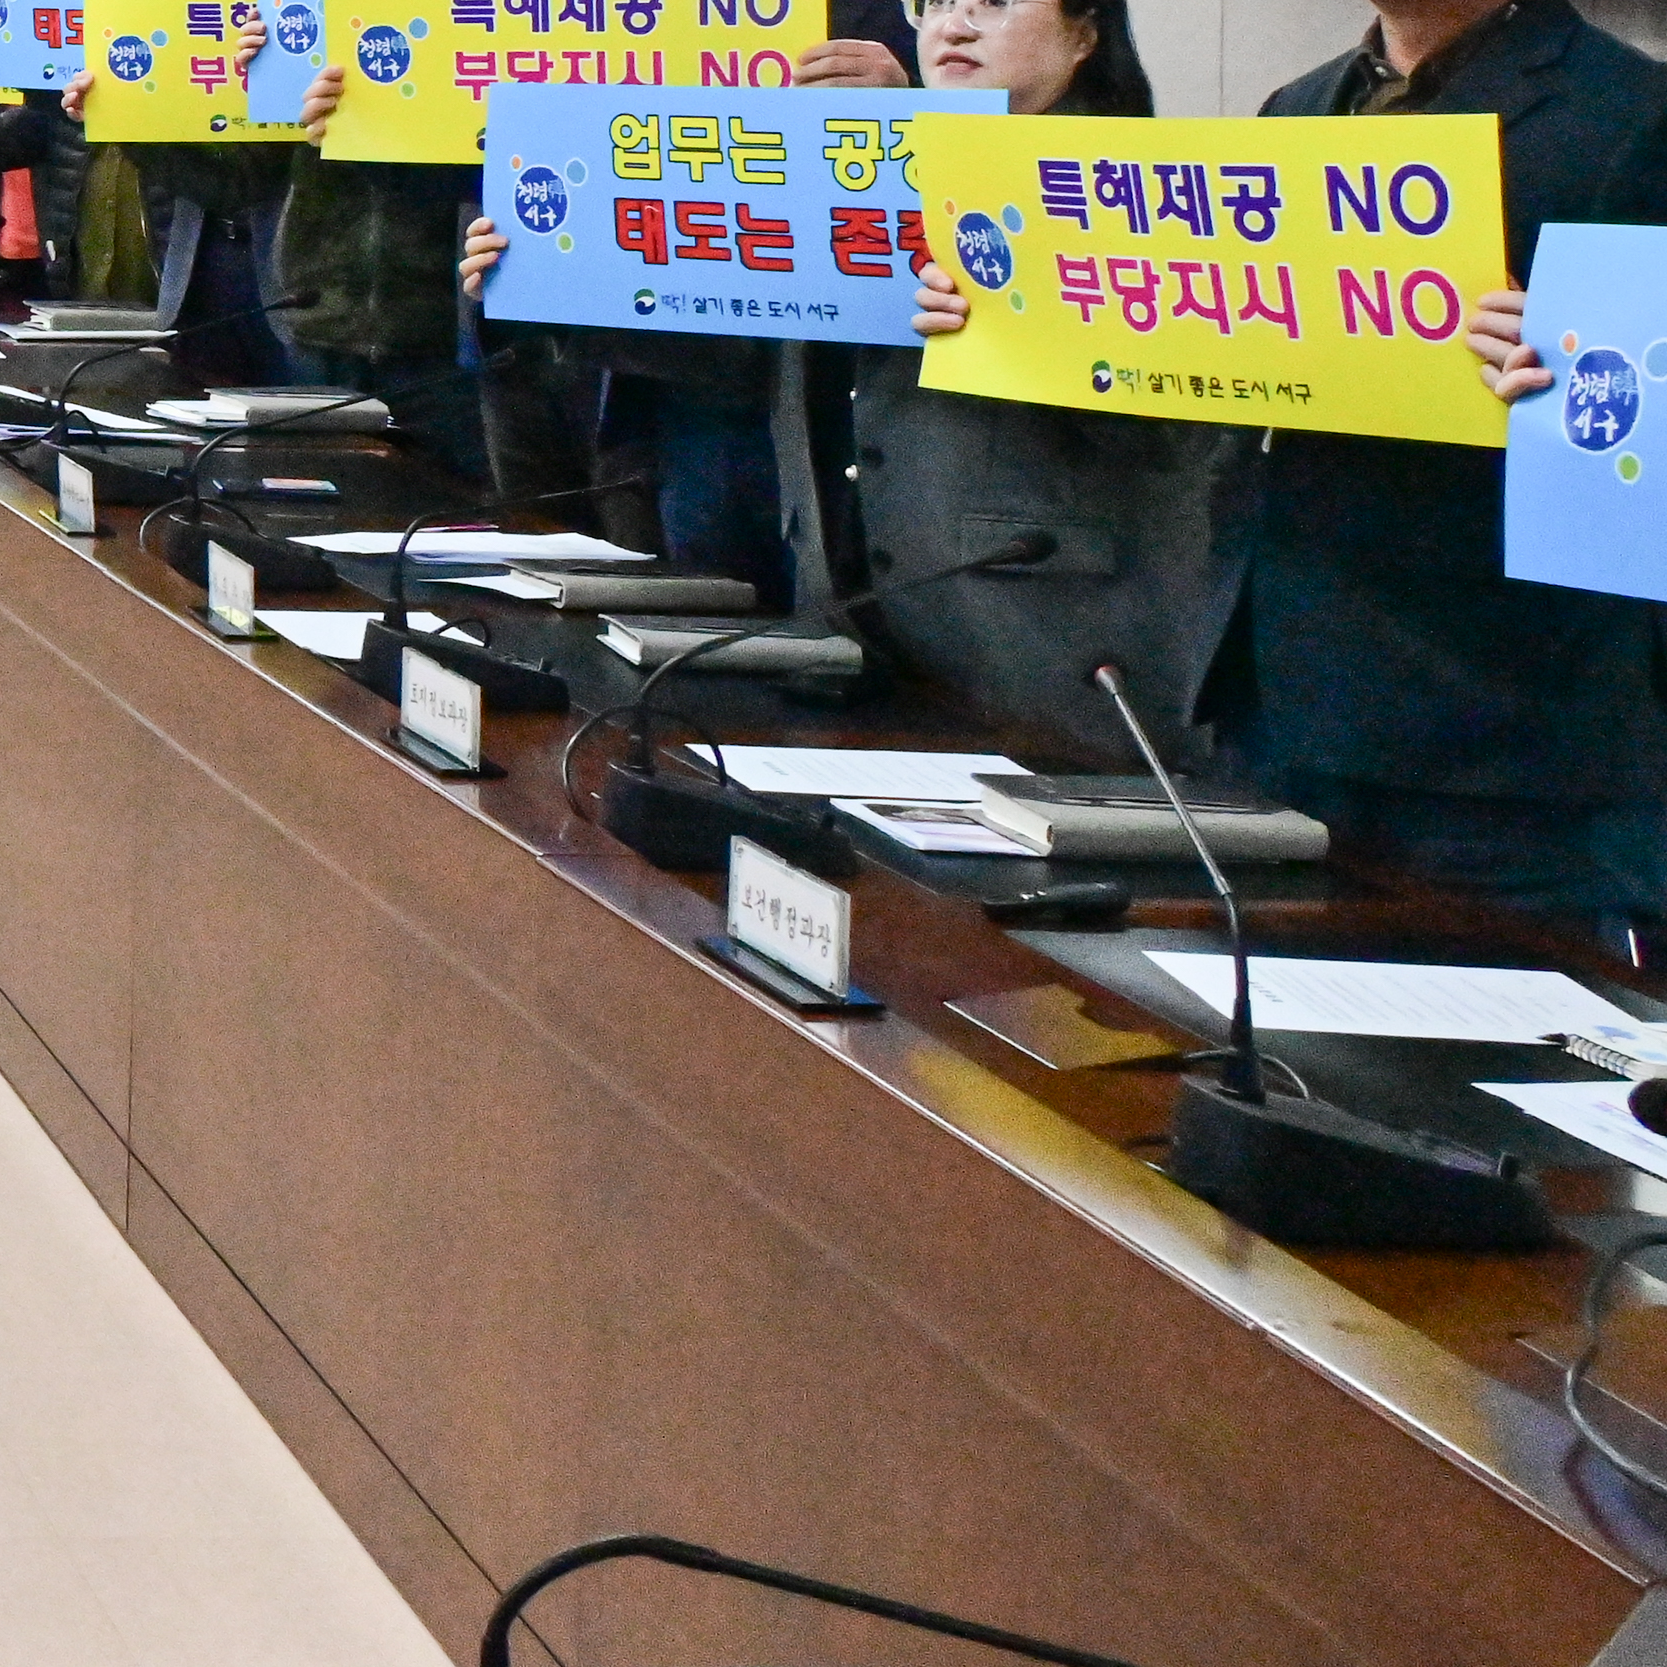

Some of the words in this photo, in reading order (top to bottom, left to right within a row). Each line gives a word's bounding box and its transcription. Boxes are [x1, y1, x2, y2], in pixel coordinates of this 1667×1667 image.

[454, 49, 664, 101] 부당지시
[701, 49, 793, 88] NO
[609, 113, 787, 185] 업무는
[614, 197, 795, 272] 태도는
[1037, 158, 1282, 243] 특혜제공
[1324, 163, 1451, 236] NO
[692, 296, 725, 314] 살기
[730, 298, 761, 318] 좋은
[767, 301, 802, 321] 도시
[806, 303, 841, 322] 서구
[1054, 253, 1301, 340] 부당지시
[1337, 268, 1463, 341] NO
[1147, 372, 1183, 395] 살기
[1189, 375, 1224, 398] 좋은
[1231, 378, 1269, 402] 도시
[1275, 380, 1313, 405] 서구
